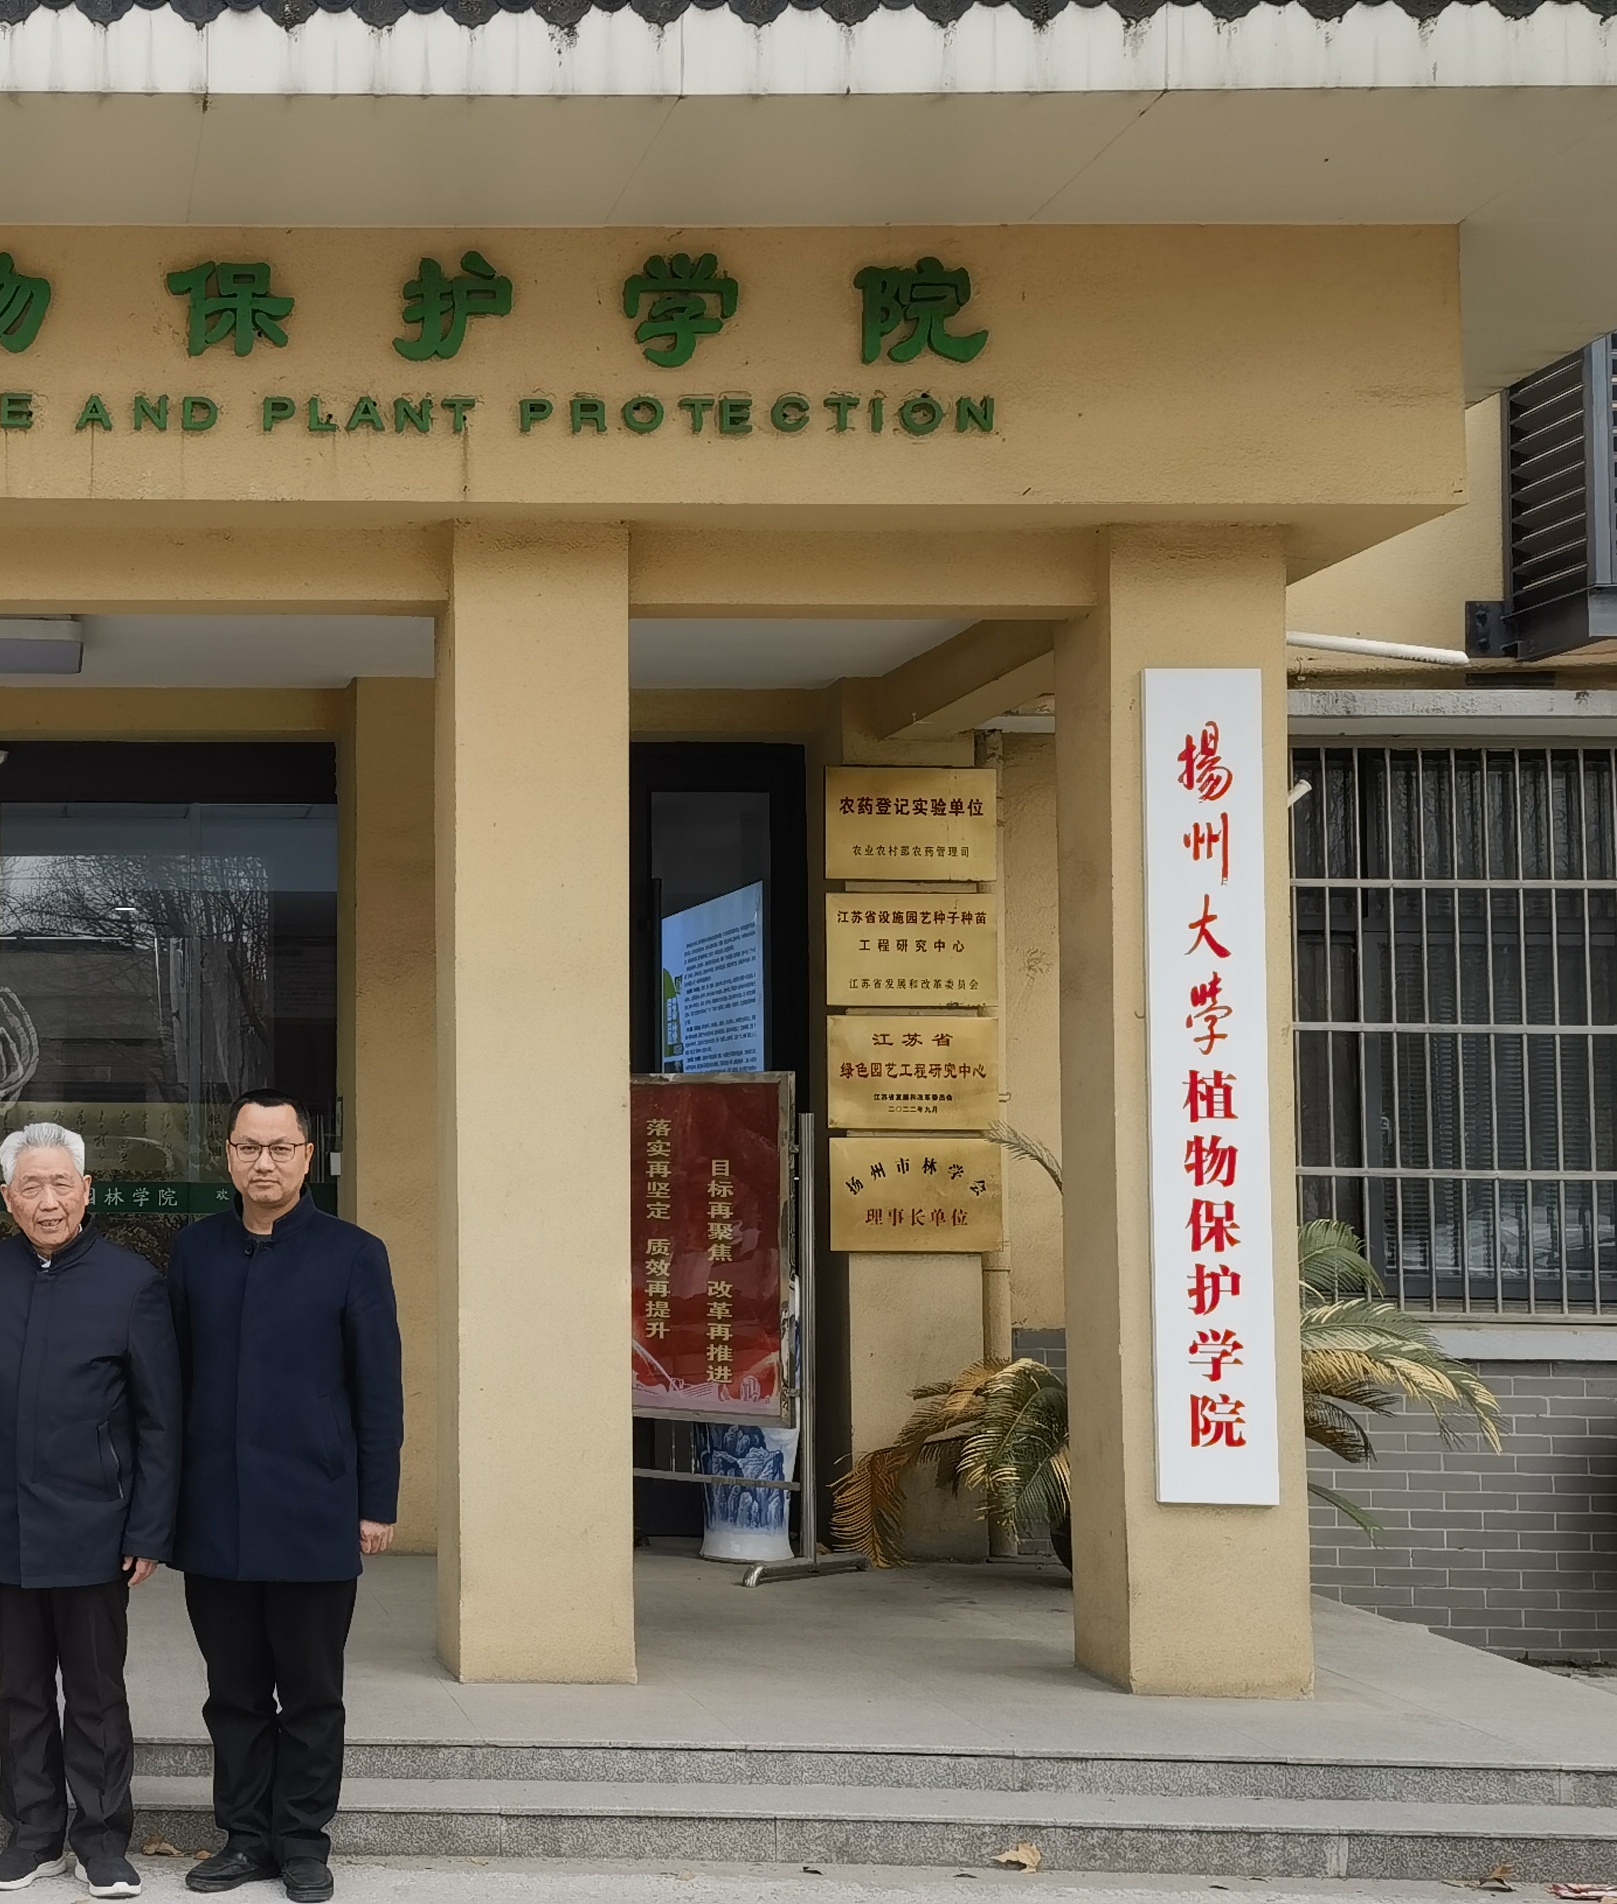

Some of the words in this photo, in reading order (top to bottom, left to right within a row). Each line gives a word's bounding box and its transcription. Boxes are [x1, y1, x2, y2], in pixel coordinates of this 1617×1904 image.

[77, 392, 218, 432] AND
[262, 395, 476, 433] PLANT
[519, 393, 996, 434] PROTECTION
[839, 797, 984, 817] 农药登记实验单位
[852, 845, 970, 858] 农业农村部农药管理司
[837, 910, 987, 925] 江苏省设施园艺种子种苗
[859, 938, 965, 952] 工程研究中心
[872, 1033, 953, 1047] 江苏省
[839, 1062, 987, 1079] 绿色园艺工程研究中心
[646, 1119, 671, 1220] 落实再坚定
[845, 1157, 987, 1196] 扬州市林学会
[706, 1159, 734, 1262] 目标再聚焦
[865, 1208, 968, 1226] 理事长单位
[645, 1238, 671, 1339] 质效再提升
[706, 1280, 734, 1384] 改革再推进
